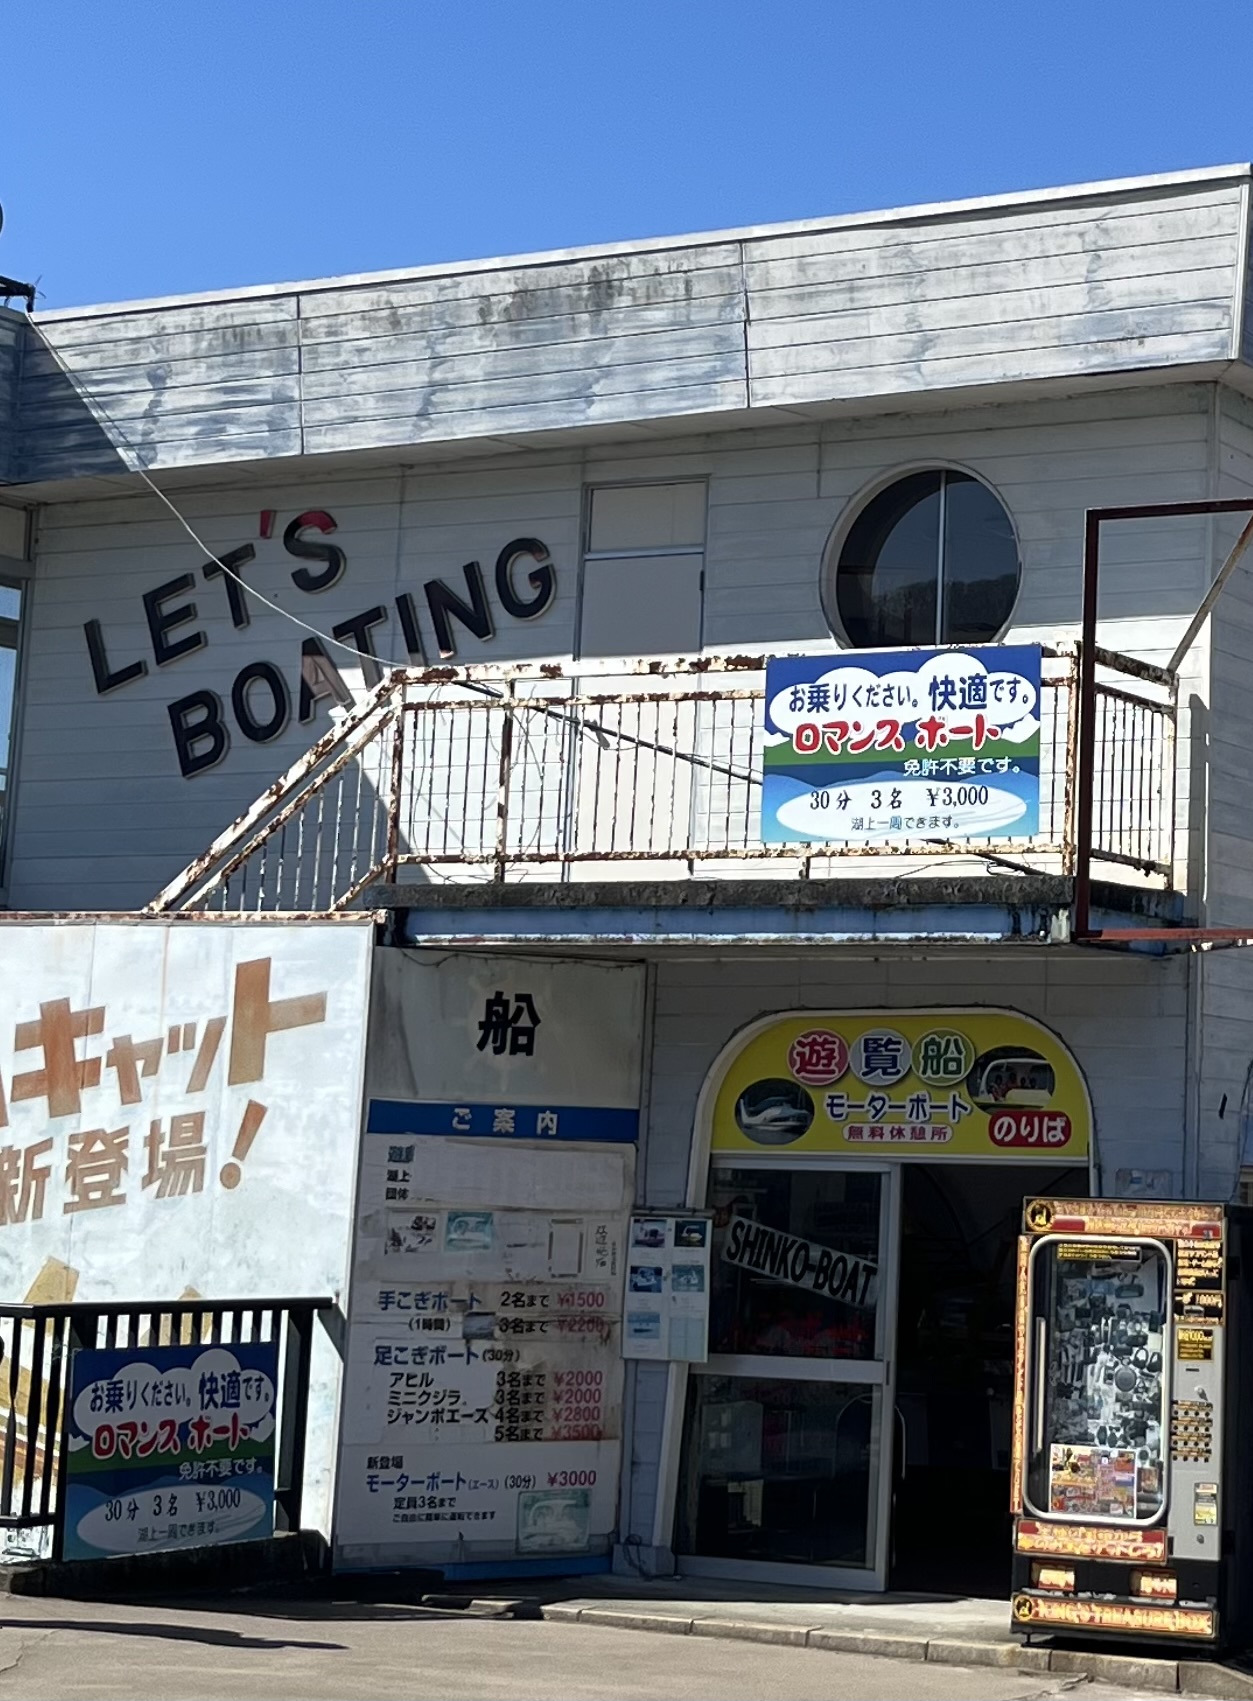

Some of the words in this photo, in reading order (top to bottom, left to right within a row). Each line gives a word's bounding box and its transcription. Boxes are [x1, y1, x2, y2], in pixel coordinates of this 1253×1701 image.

[84, 510, 346, 694] LET'S
[168, 537, 557, 778] BOATING
[794, 718, 904, 754] ロマンス
[916, 714, 1001, 752] ボート
[903, 756, 1020, 777] 免許不要です。
[0, 957, 327, 1127] キャット
[795, 1035, 965, 1078] 遊覧船
[452, 1107, 558, 1135] ご案内
[825, 1093, 973, 1122] モーターボート
[847, 1125, 948, 1141] 無料休憩所
[993, 1115, 1066, 1144] のりば
[726, 1219, 878, 1305] SHINKO-BOAT
[378, 1290, 482, 1312] 手こぎボート
[501, 1292, 549, 1308] 2名まで
[374, 1345, 479, 1366] 足こぎボート
[390, 1372, 434, 1388] アヒル
[497, 1372, 546, 1387] 3名まで
[554, 1371, 603, 1386] ¥2000
[495, 1390, 545, 1405] 3名まで
[553, 1389, 601, 1404] ¥2000
[494, 1407, 544, 1423] 4名まで
[552, 1407, 600, 1422] ¥2800
[93, 1419, 180, 1458] ロマンス
[188, 1412, 250, 1453] ボート
[495, 1426, 543, 1441] 5名まで
[547, 1470, 596, 1487] ¥3000
